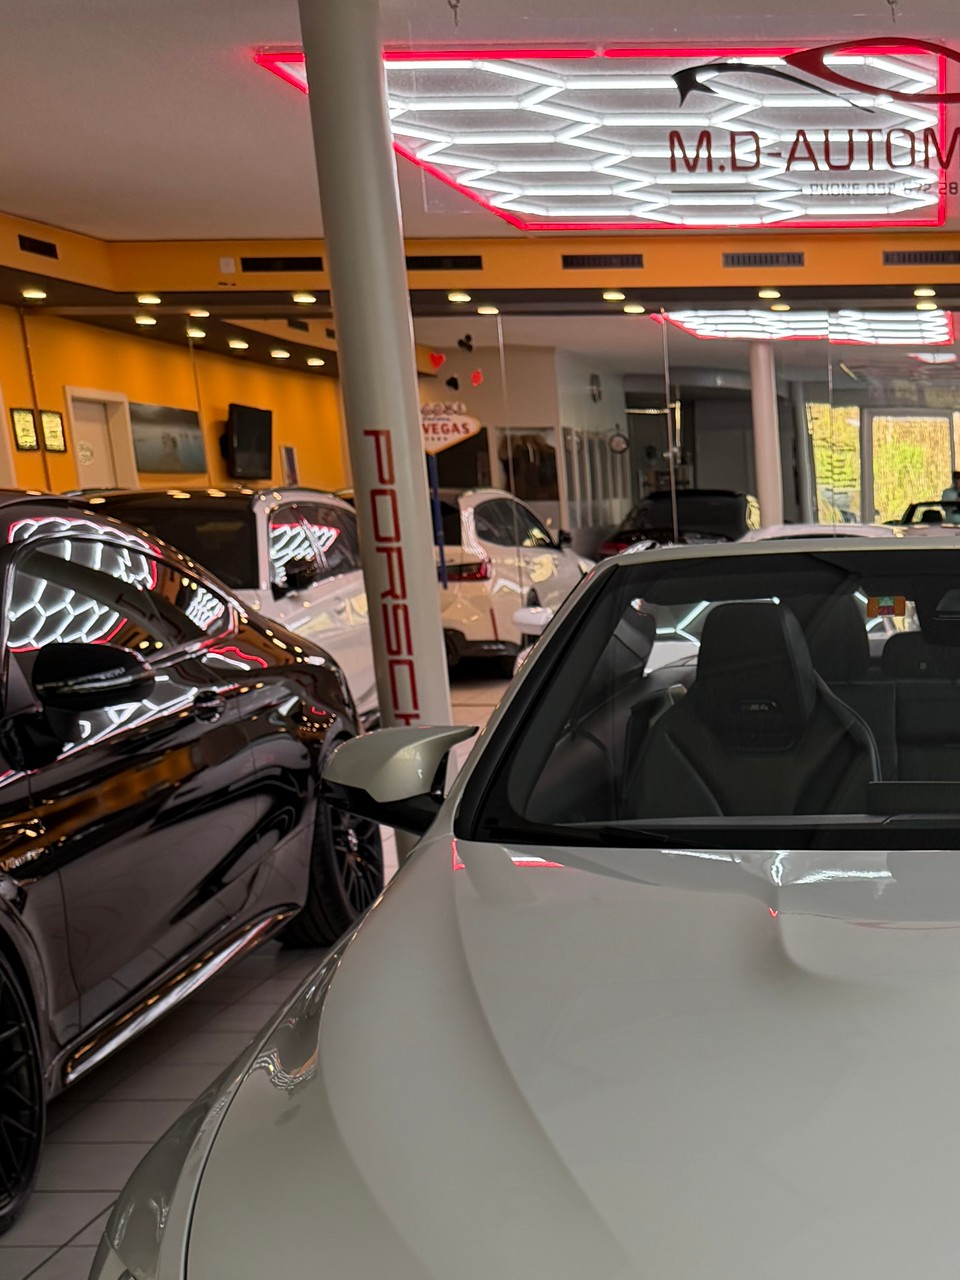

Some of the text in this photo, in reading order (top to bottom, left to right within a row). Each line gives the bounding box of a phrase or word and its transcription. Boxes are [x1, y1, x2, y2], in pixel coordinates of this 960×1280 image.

[809, 182, 862, 196] PHONE
[938, 181, 958, 196] 28
[422, 422, 470, 435] VEGAS
[363, 429, 420, 726] PORSC
